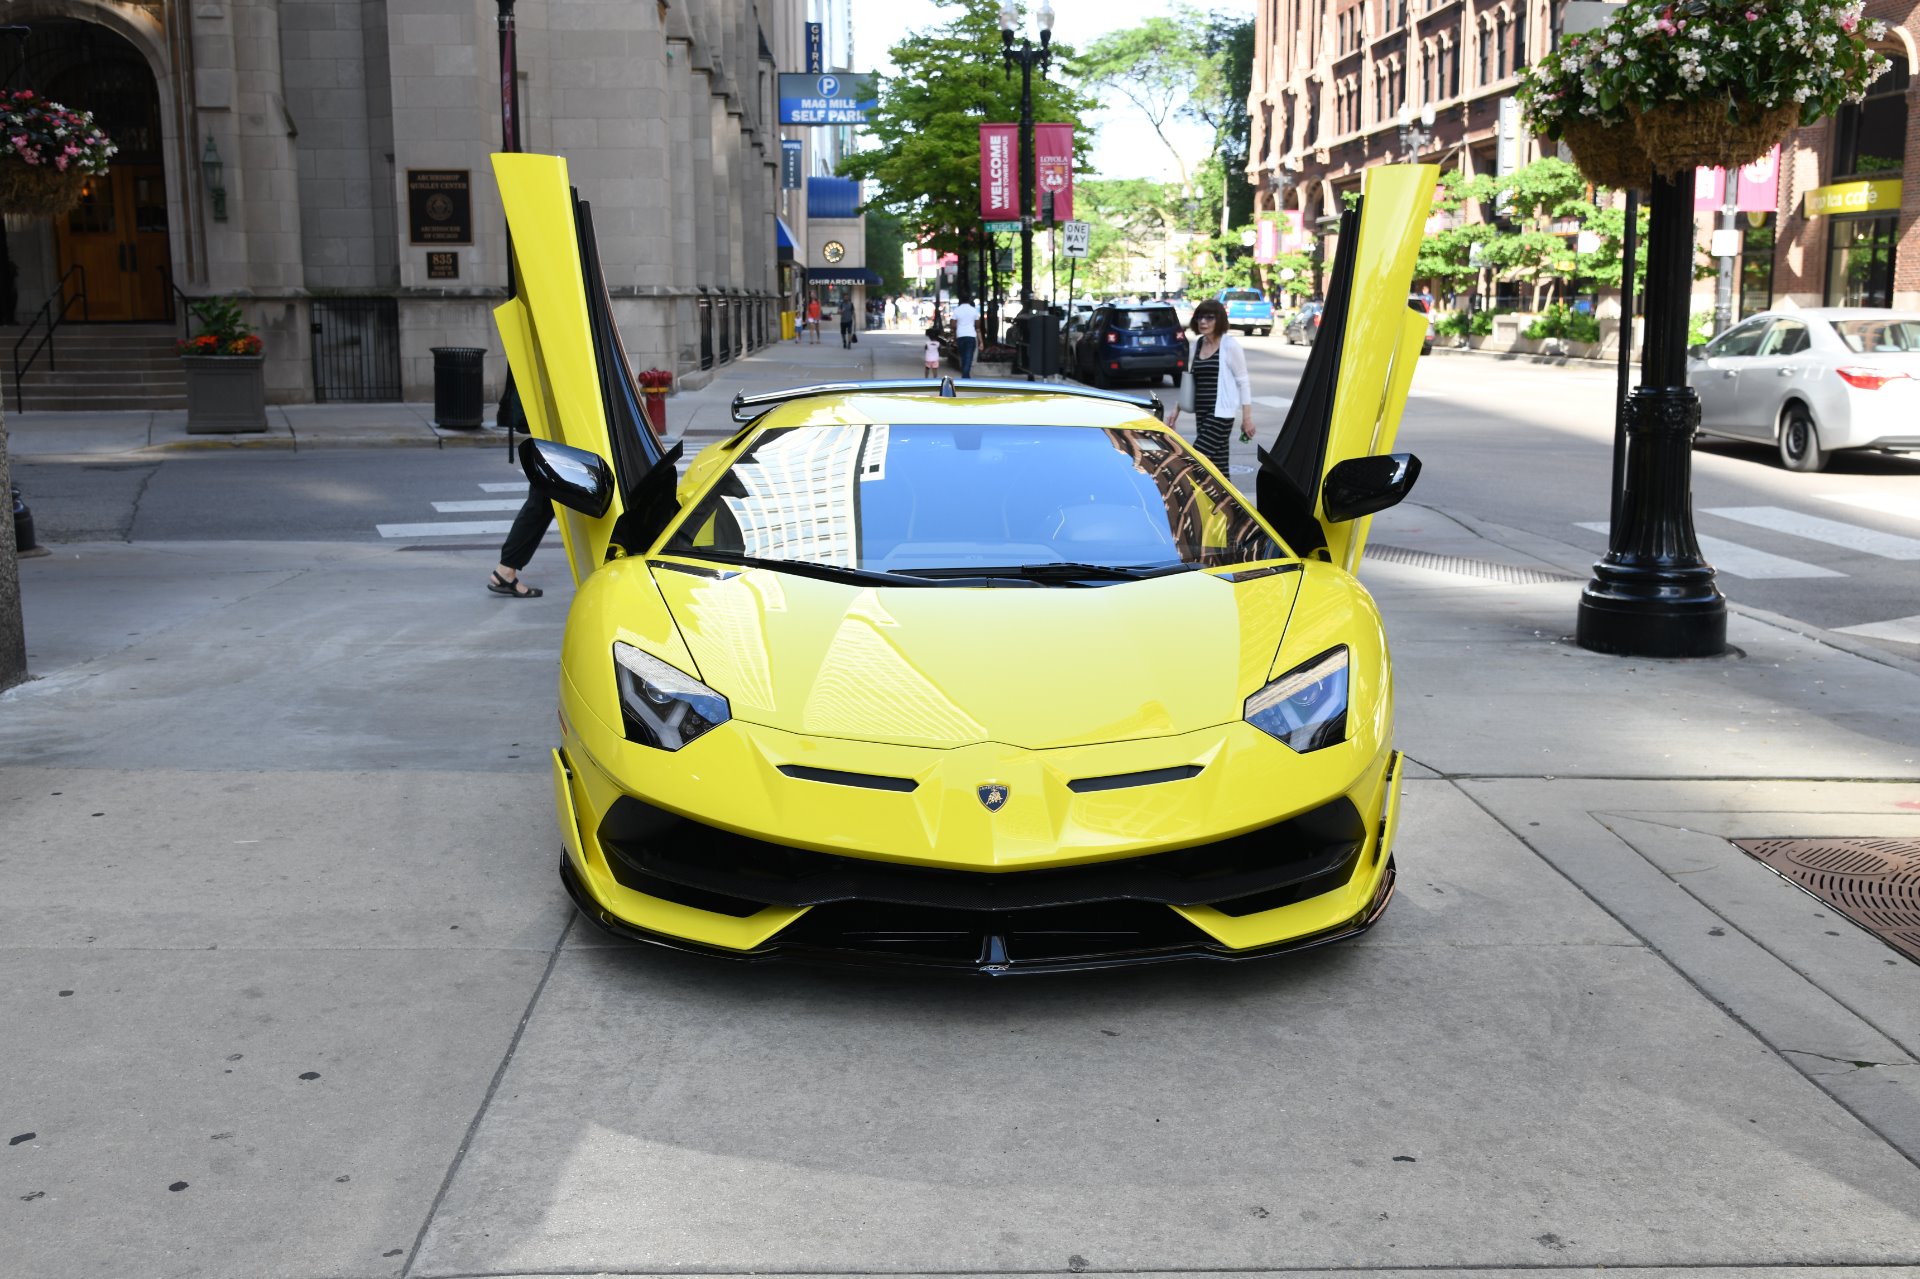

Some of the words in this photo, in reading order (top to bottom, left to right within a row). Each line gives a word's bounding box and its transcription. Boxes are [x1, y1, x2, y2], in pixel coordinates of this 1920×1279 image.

[822, 78, 835, 94] P
[801, 99, 827, 109] MAG
[830, 99, 857, 109] MILE
[791, 110, 825, 122] SELF
[828, 110, 867, 122] PARK
[990, 135, 1003, 209] WELCOME
[1846, 181, 1878, 206] café
[1067, 225, 1086, 234] ONE
[1066, 234, 1086, 242] WAY
[432, 254, 453, 265] 835
[808, 278, 865, 286] GHIRARDELLI
